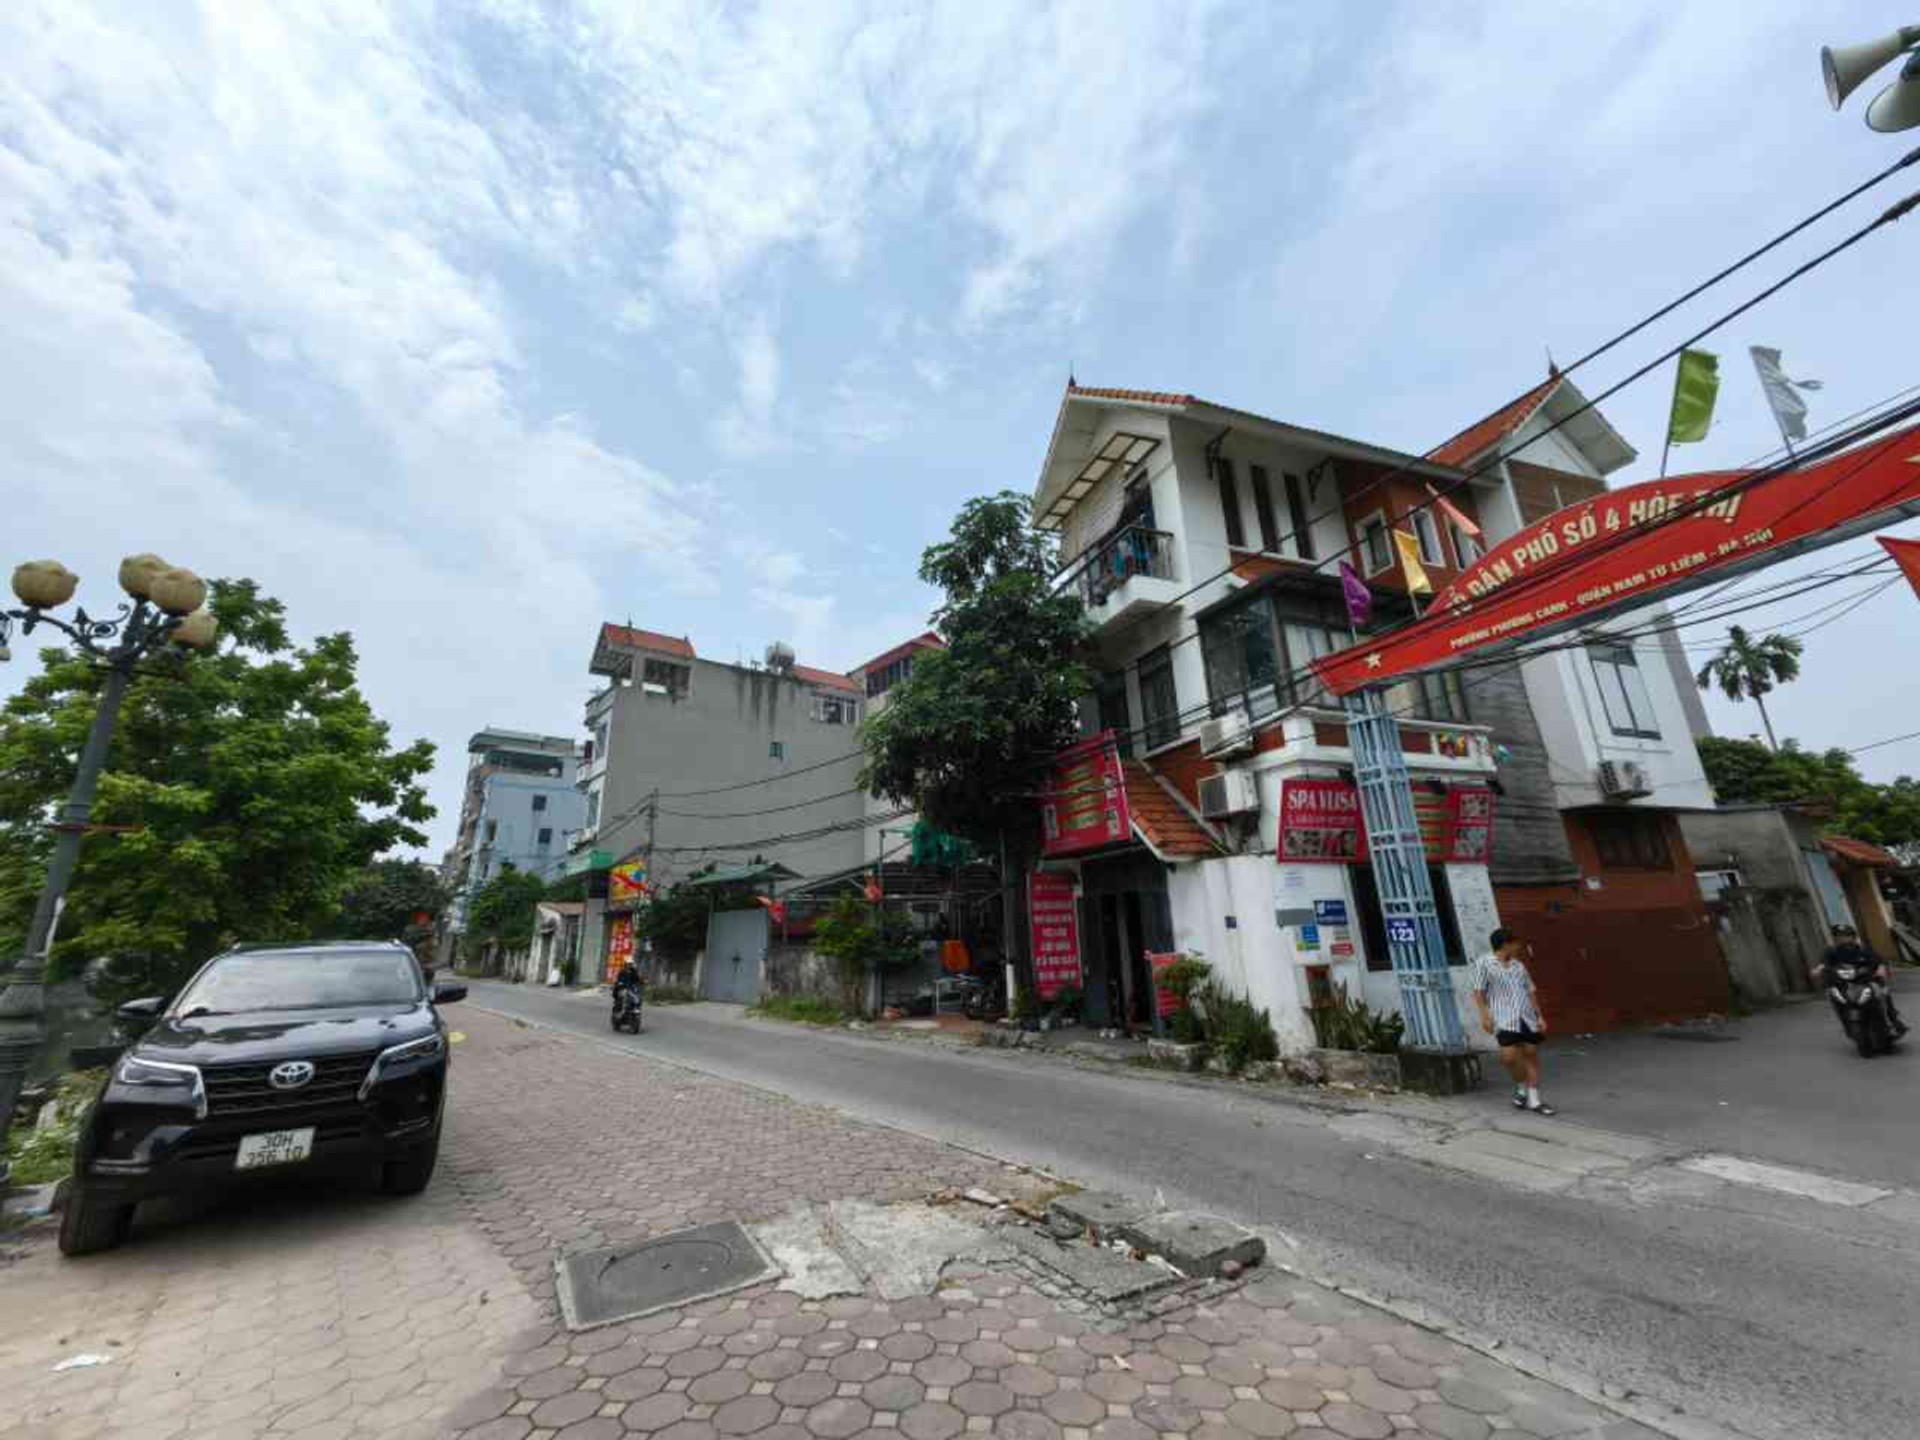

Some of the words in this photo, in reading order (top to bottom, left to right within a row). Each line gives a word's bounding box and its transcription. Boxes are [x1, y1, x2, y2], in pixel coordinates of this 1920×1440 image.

[1512, 522, 1559, 569] PHỐ
[1562, 504, 1598, 546] SỐ
[1604, 507, 1620, 532] 4
[1614, 571, 1646, 592] NAM
[1287, 789, 1316, 811] SPA
